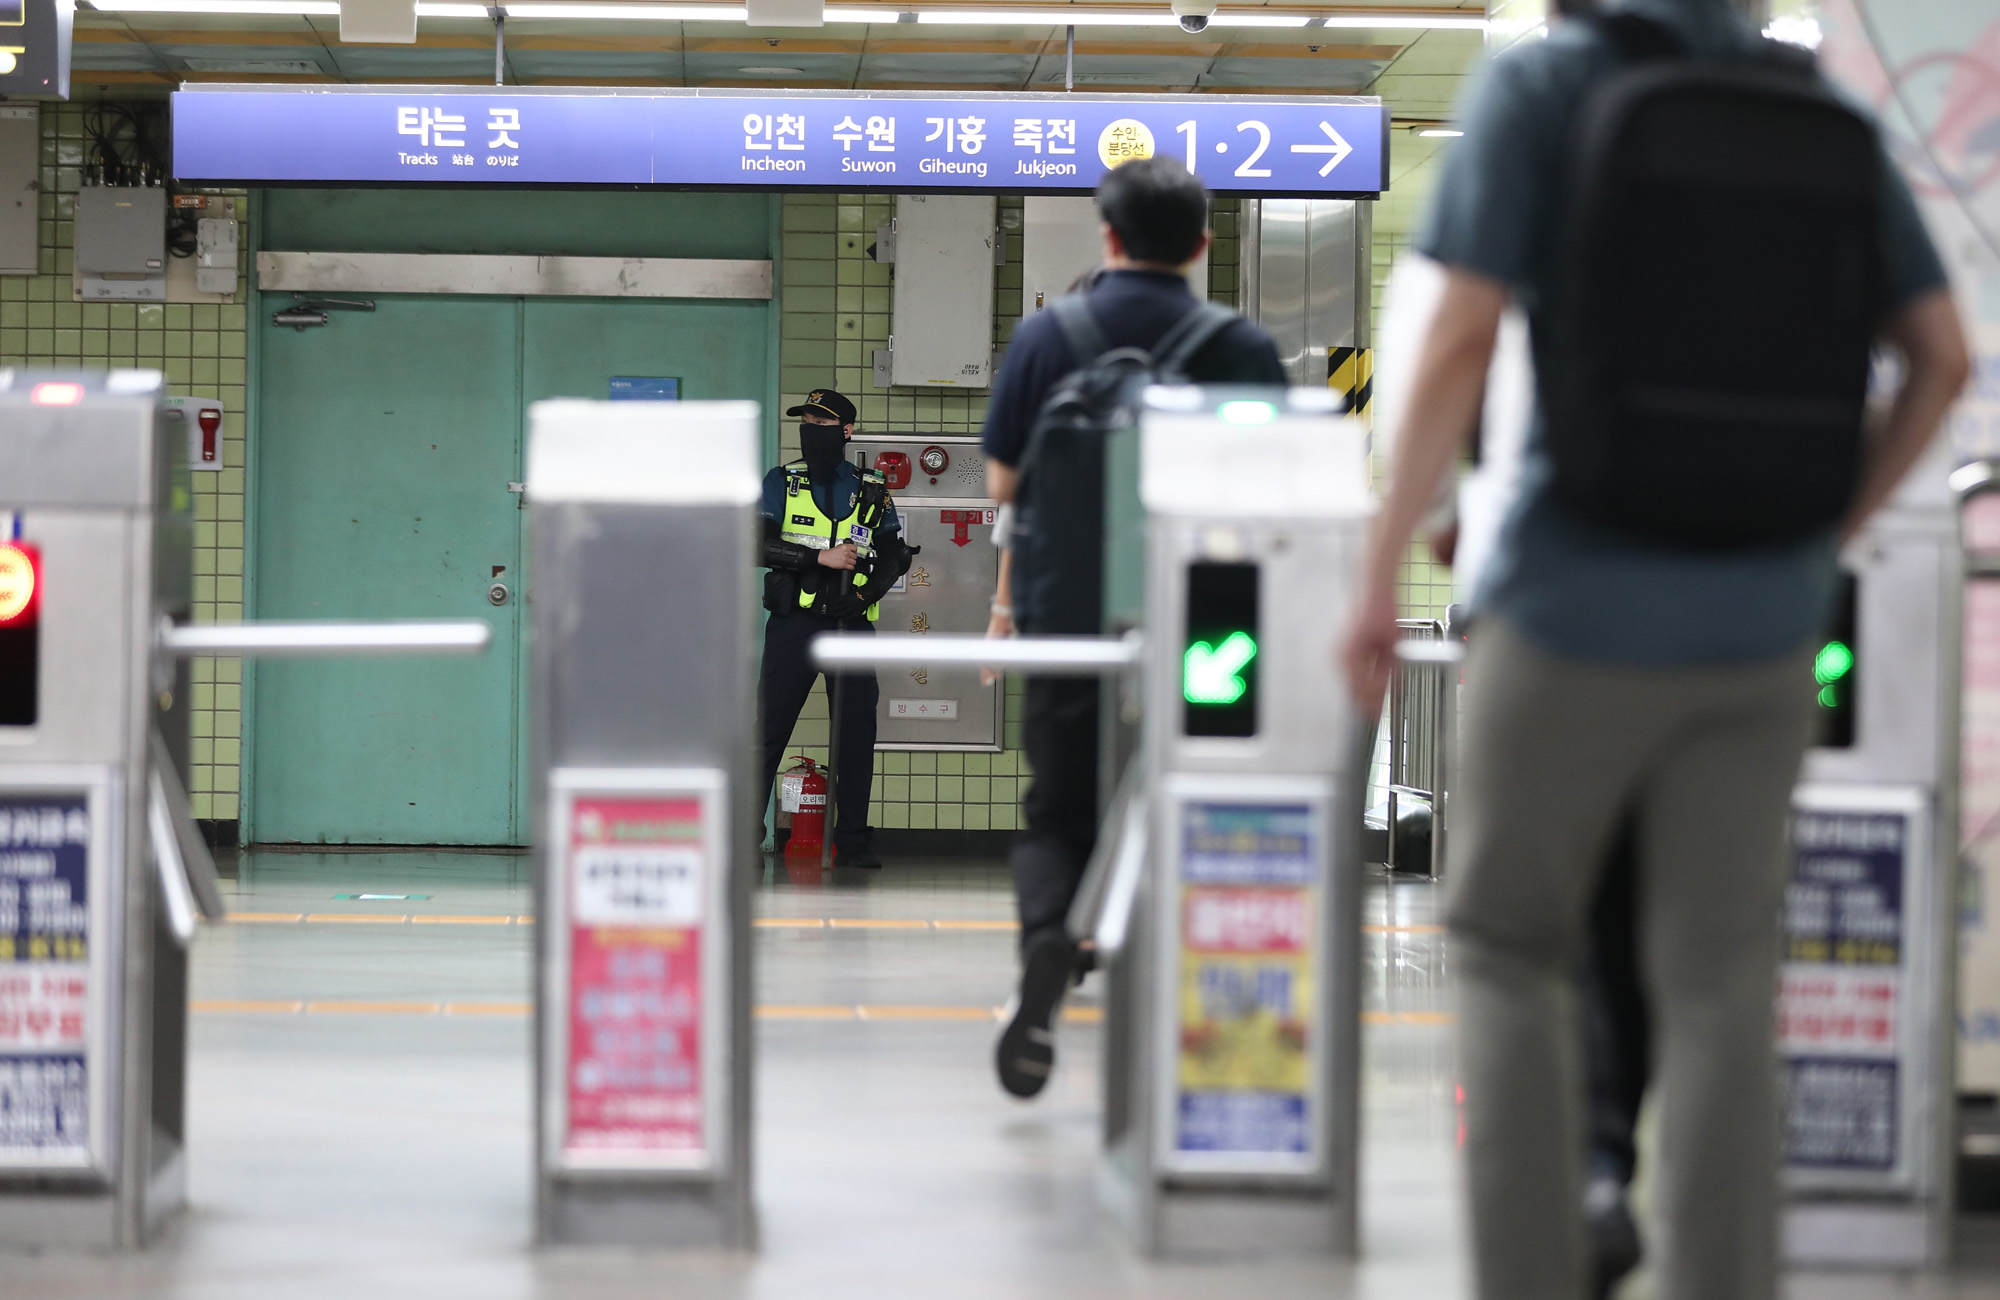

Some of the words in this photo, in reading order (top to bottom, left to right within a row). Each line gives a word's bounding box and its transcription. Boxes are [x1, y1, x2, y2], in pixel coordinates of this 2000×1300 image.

[398, 107, 467, 147] 타는
[487, 108, 521, 149] 곳
[743, 113, 805, 150] 인천
[832, 115, 896, 152] 수원
[925, 115, 987, 155] 기흥
[1012, 118, 1076, 154] 죽전
[1108, 142, 1145, 156] 분당선
[398, 152, 439, 166] Tracks
[452, 154, 474, 166] 站台
[487, 155, 519, 167] のりば
[741, 155, 806, 171] Incheon
[841, 157, 896, 173] Suwon
[919, 158, 988, 178] Giheung
[1014, 159, 1077, 178] Jukjeon
[986, 510, 994, 524] 9
[850, 535, 867, 543] POLICE
[801, 795, 825, 805] 오리역
